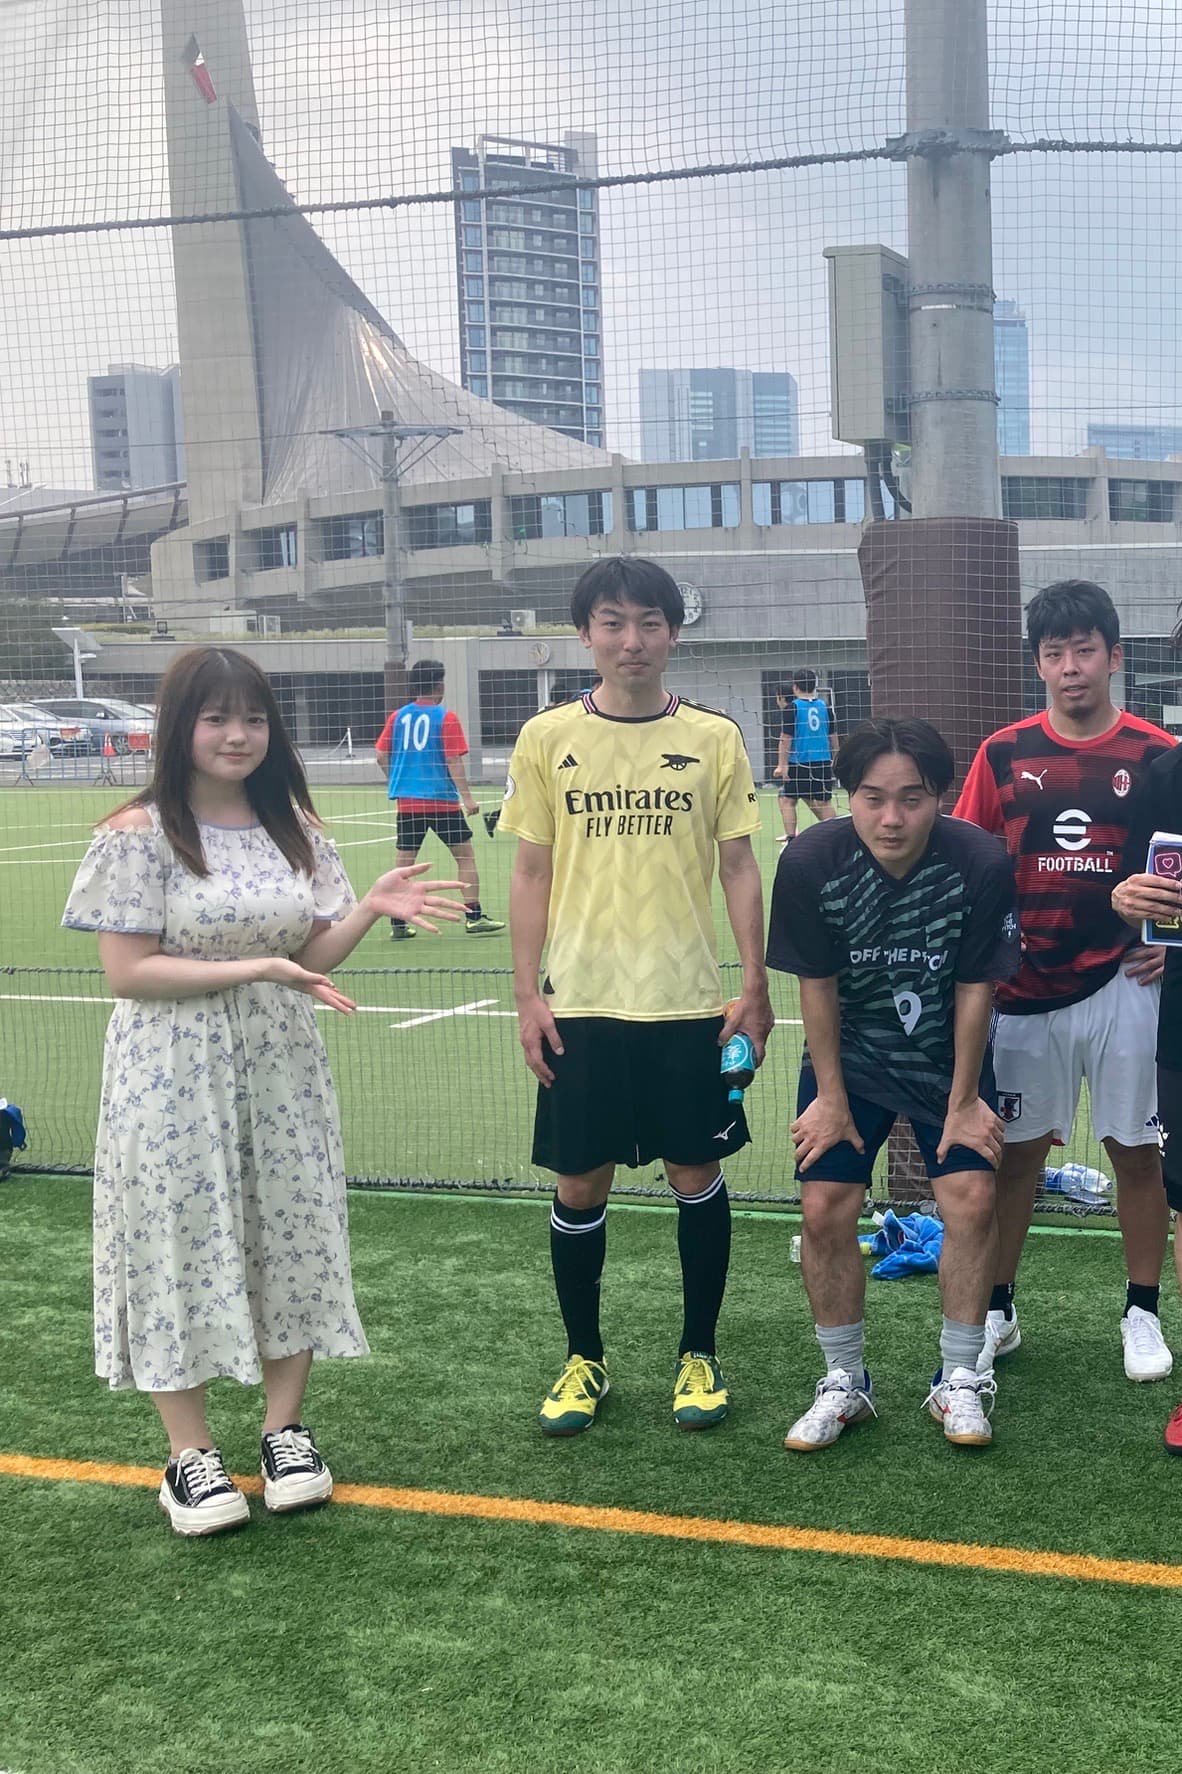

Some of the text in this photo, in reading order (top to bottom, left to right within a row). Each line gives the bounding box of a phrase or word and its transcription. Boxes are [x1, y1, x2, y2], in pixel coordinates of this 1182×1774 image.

[808, 707, 820, 731] 6
[401, 713, 430, 751] 10
[565, 785, 693, 815] Emirates
[586, 815, 673, 838] FLY BETTER
[1038, 857, 1113, 872] FOOTBALL
[850, 946, 881, 964] OFF
